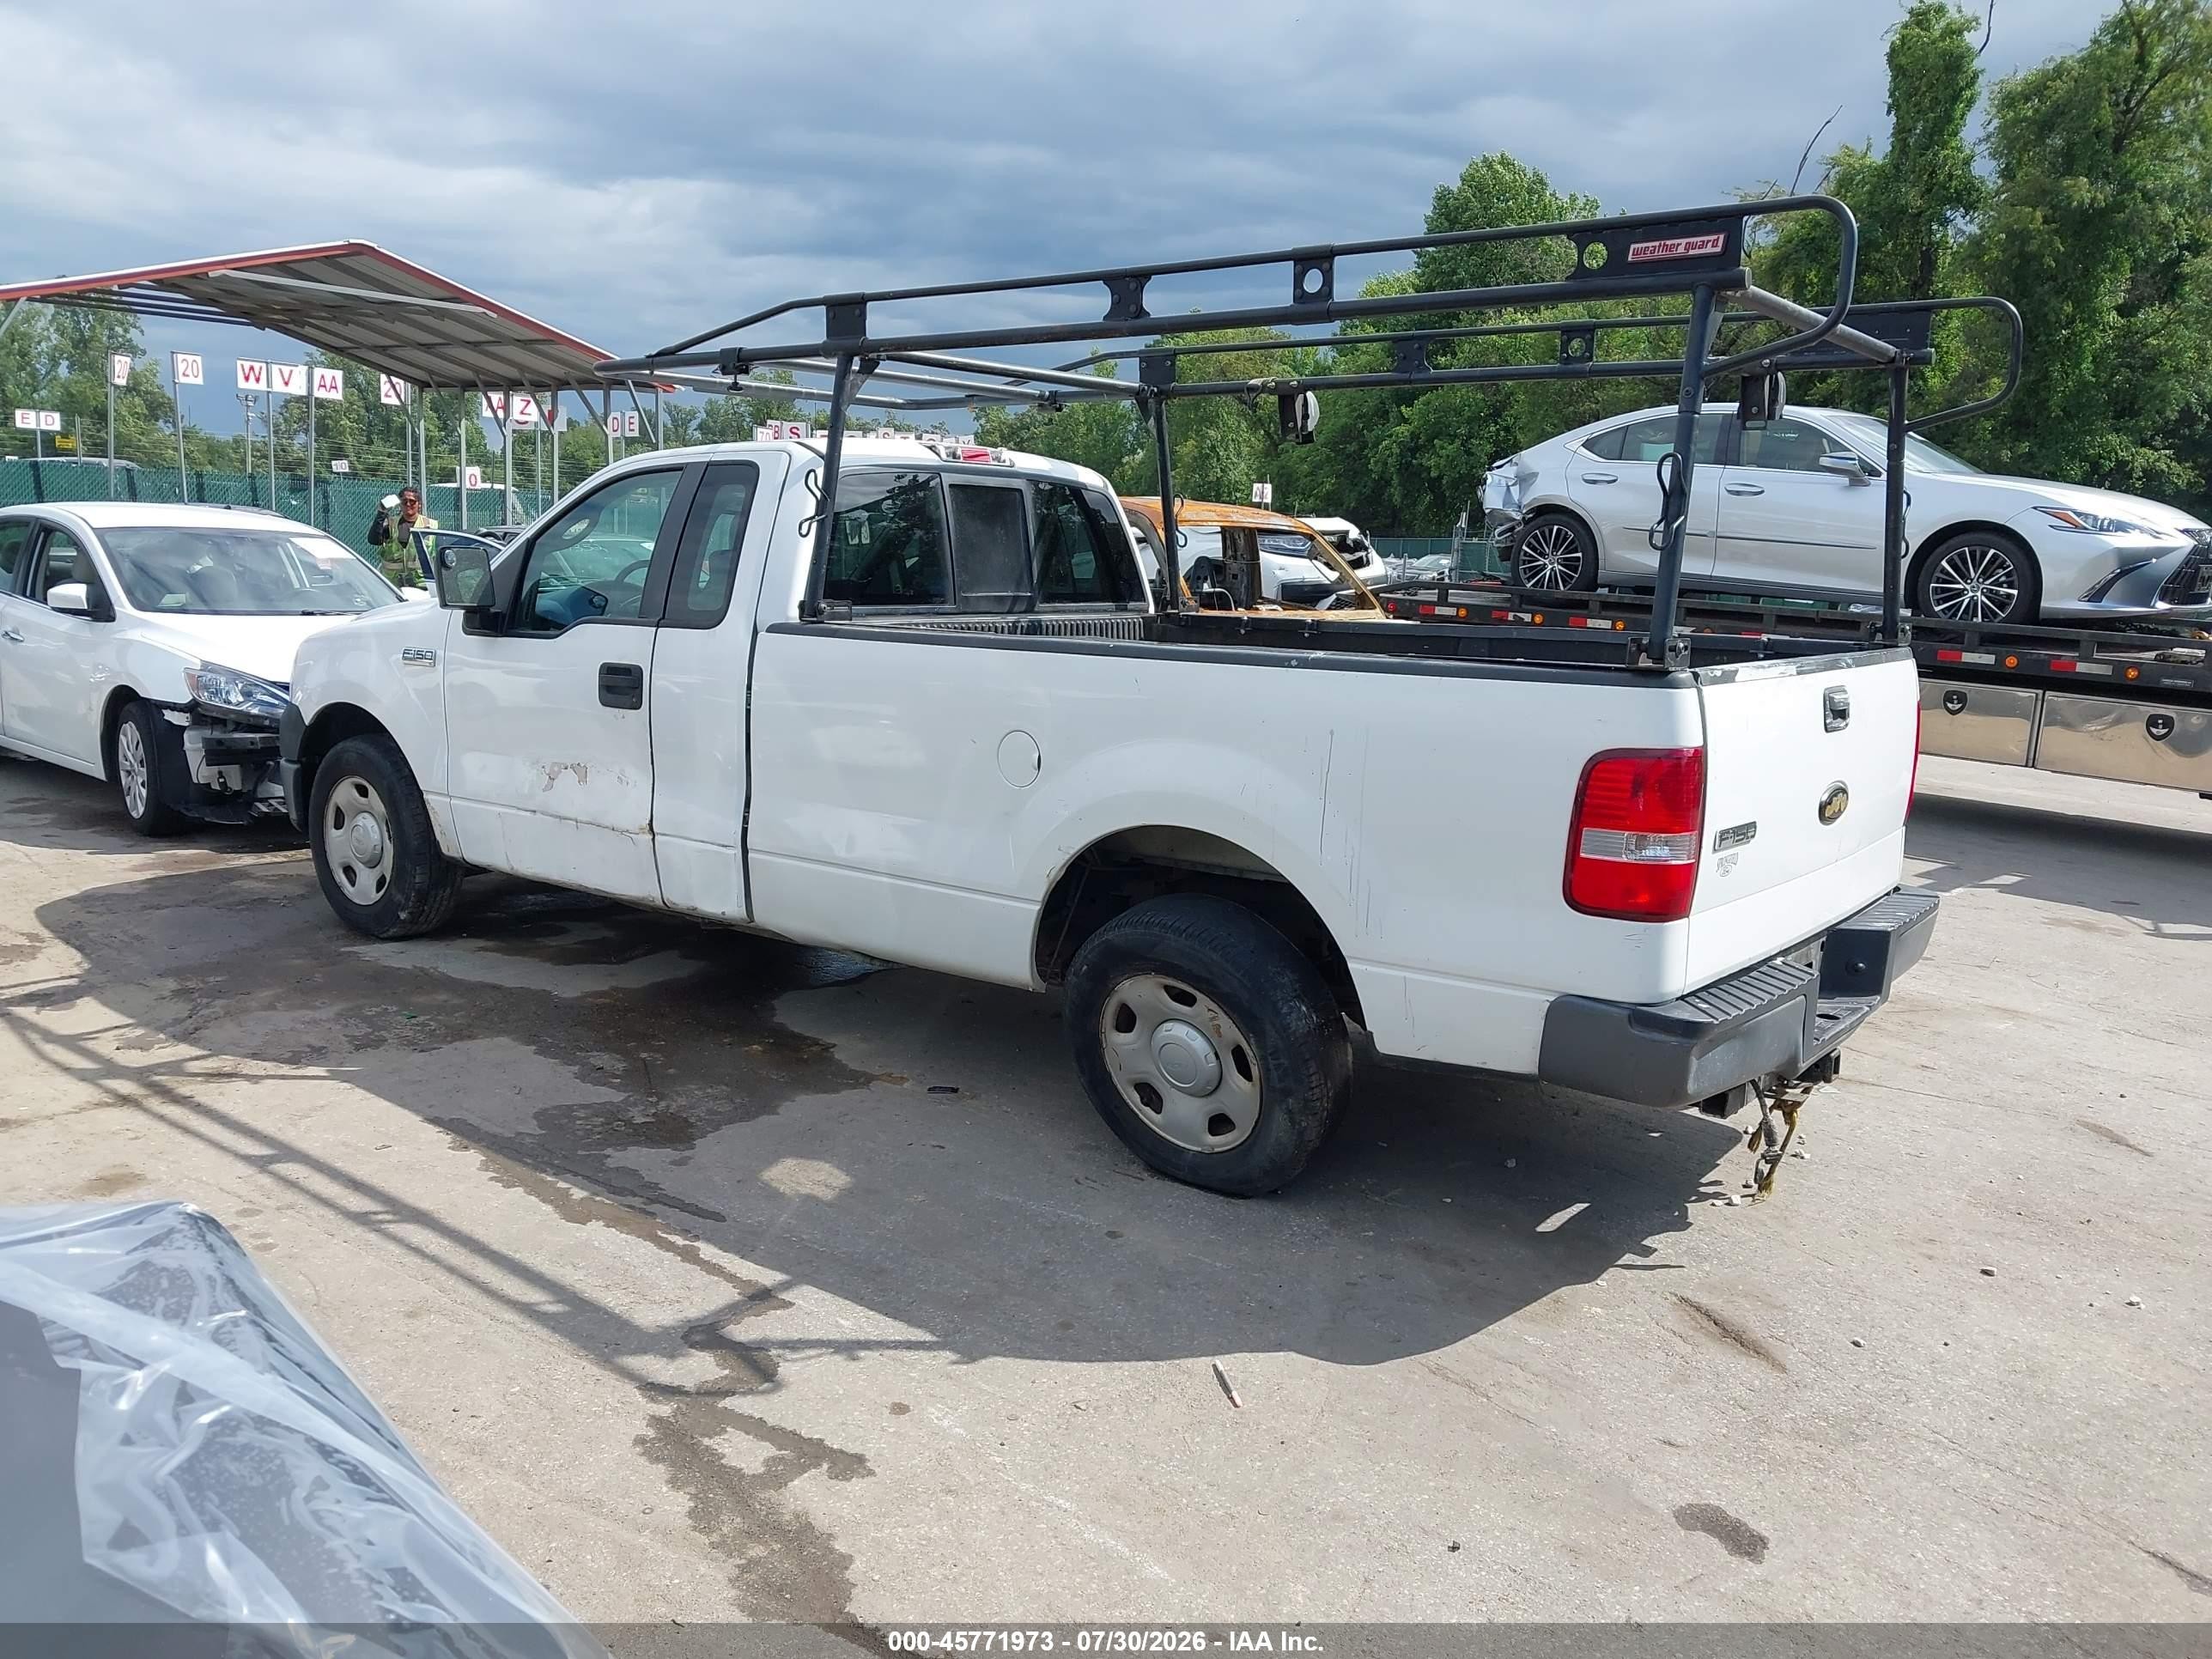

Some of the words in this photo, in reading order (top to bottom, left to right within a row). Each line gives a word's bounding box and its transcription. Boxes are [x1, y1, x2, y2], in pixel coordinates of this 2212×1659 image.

[1632, 240, 1682, 257] weather
[1684, 235, 1720, 253] guard
[117, 359, 128, 380] 20
[180, 358, 200, 379] 20
[240, 363, 263, 384] W
[277, 368, 294, 386] V
[318, 374, 338, 393] AA
[520, 398, 532, 416] Z
[21, 412, 31, 425] E
[45, 414, 55, 427] D
[611, 416, 619, 433] D
[628, 416, 635, 432] E
